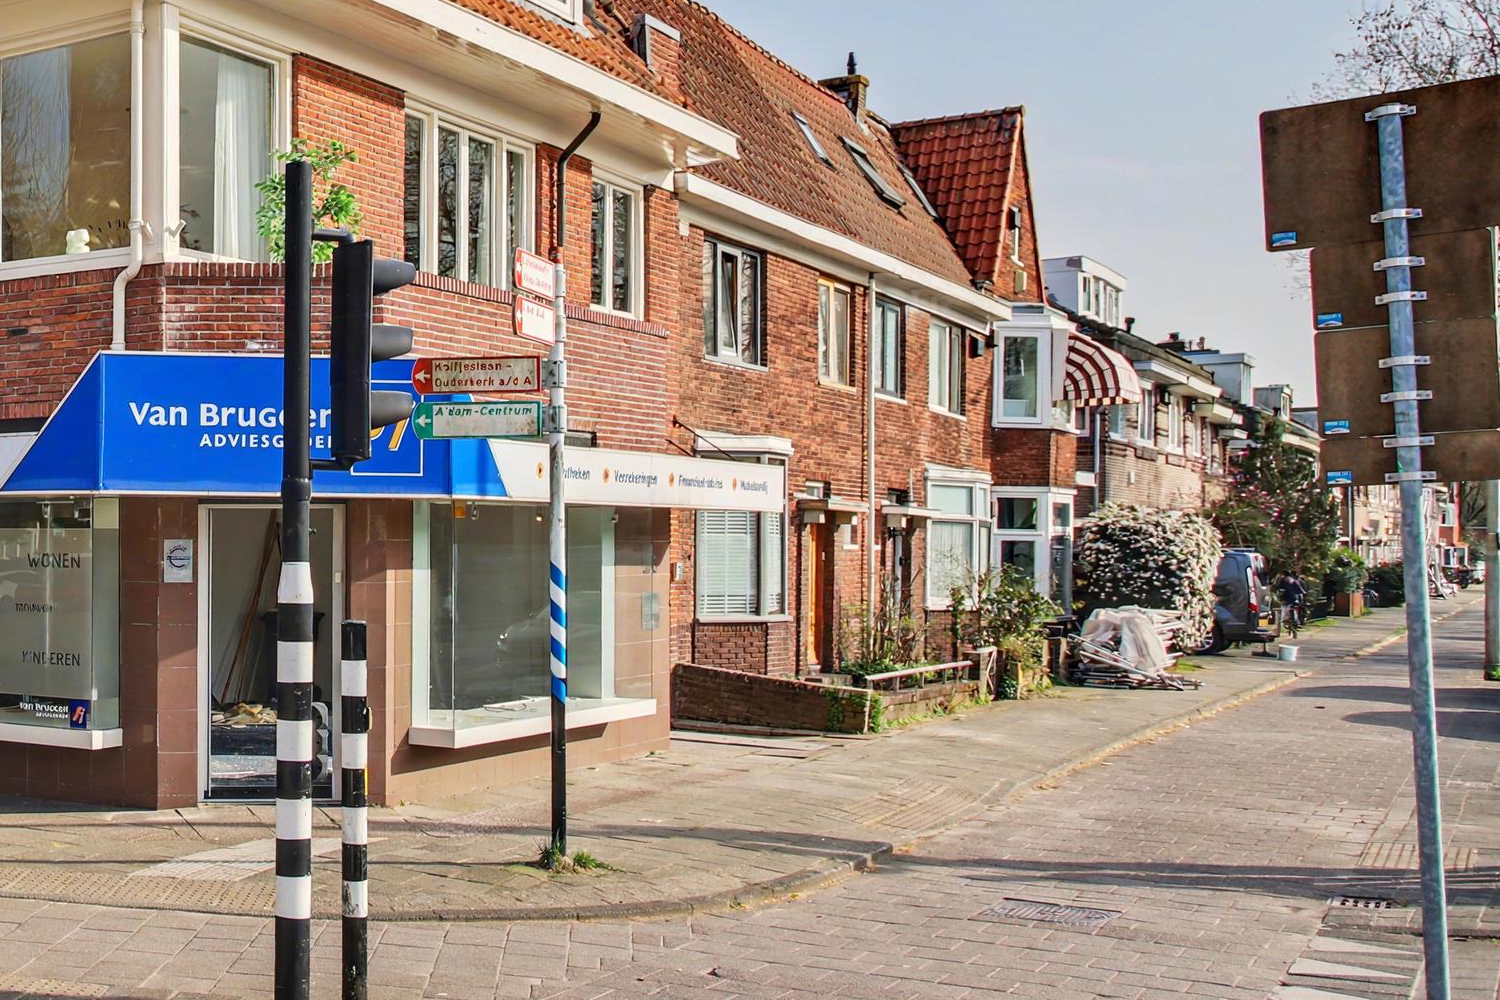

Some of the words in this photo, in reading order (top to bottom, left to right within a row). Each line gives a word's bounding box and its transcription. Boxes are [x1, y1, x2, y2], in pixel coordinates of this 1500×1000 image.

[523, 376, 532, 386] A
[128, 402, 188, 427] Van
[199, 402, 331, 428] Brugen
[199, 433, 332, 449] ADVIESGE
[27, 553, 80, 569] WONEN
